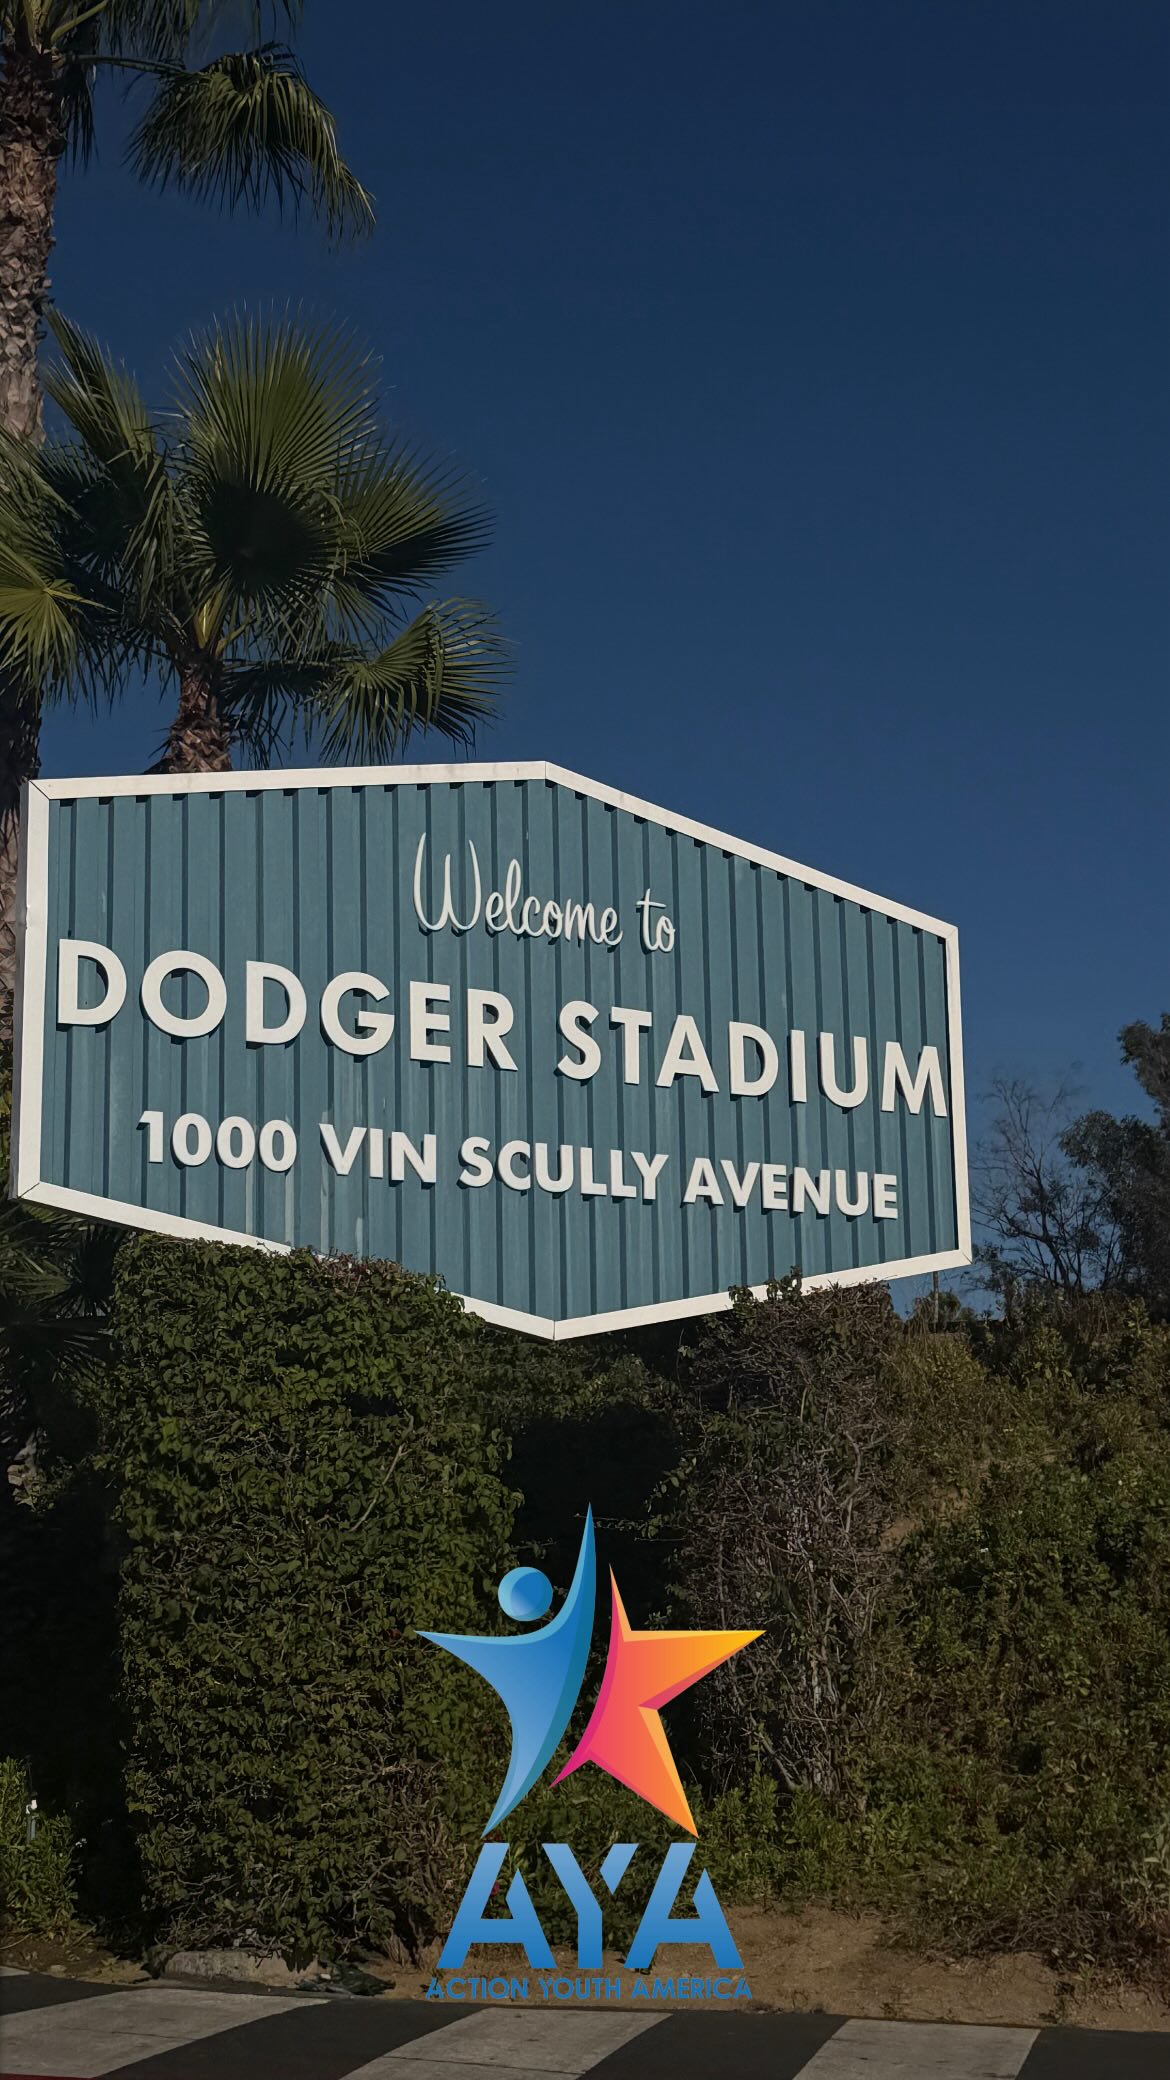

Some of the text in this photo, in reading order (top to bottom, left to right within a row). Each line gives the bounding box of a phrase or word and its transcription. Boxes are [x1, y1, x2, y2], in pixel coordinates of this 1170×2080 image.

[412, 832, 676, 953] Welcome to
[57, 938, 948, 1118] DODGER STADIUM
[138, 1111, 898, 1219] 1000 VIN SCULLY AVENUE
